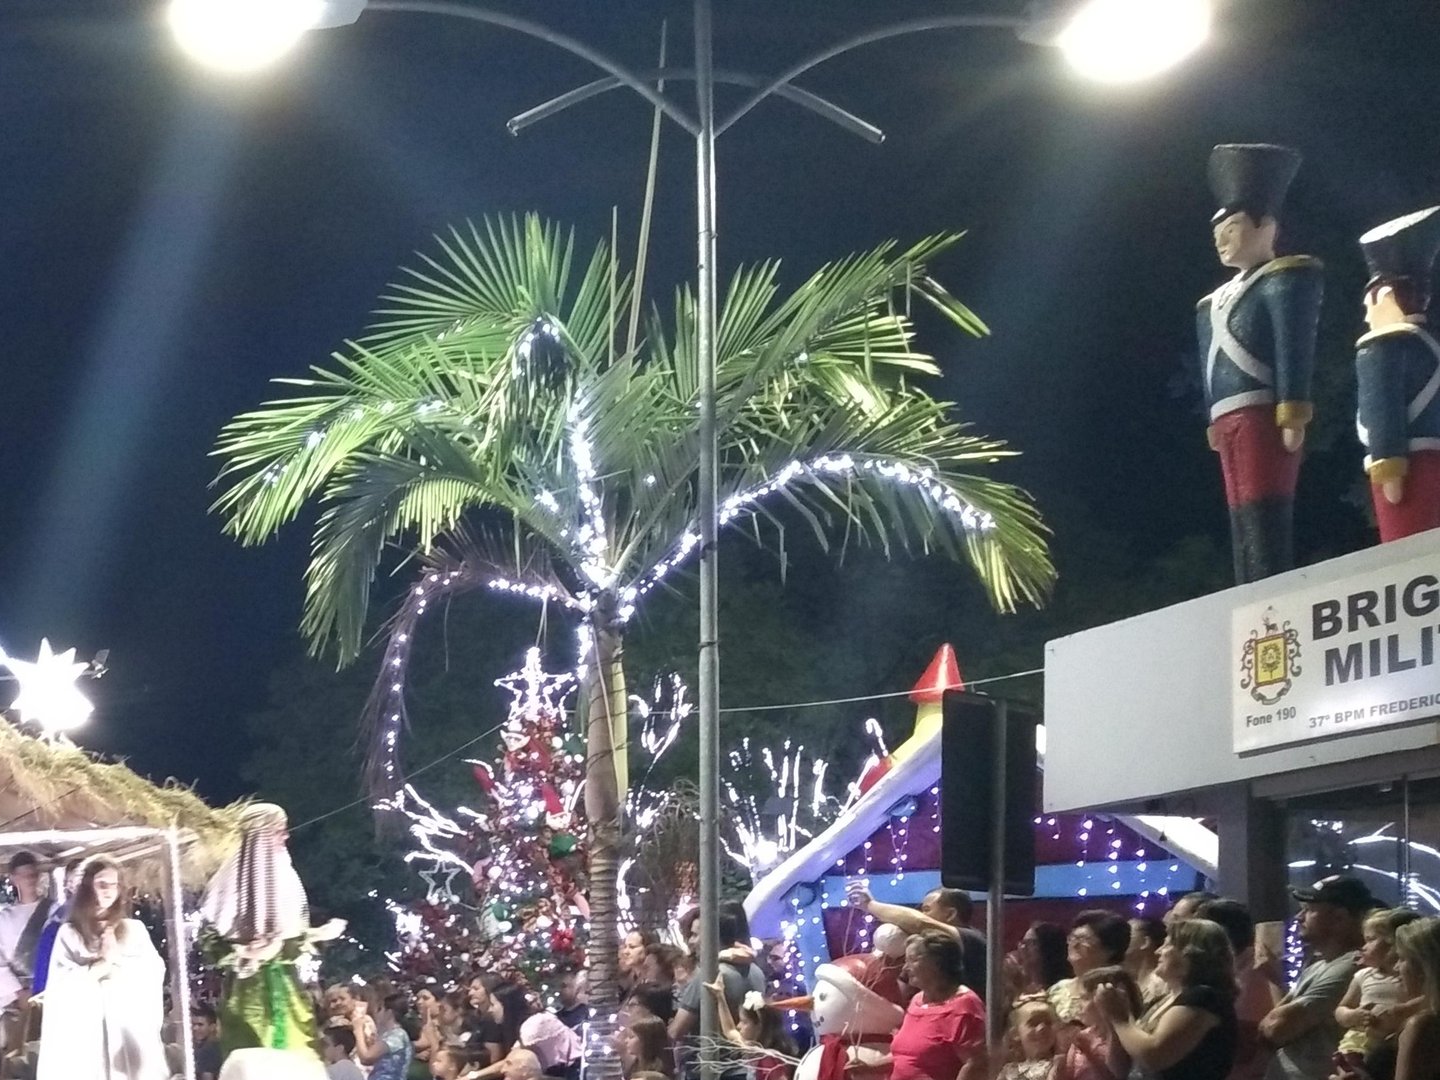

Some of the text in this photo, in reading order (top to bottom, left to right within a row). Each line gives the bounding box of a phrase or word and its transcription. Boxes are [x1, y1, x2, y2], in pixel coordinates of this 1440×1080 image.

[1312, 575, 1440, 640] BRIG
[1325, 624, 1440, 686] MILI
[1246, 706, 1297, 728] Fone 190
[1334, 708, 1365, 724] BPM
